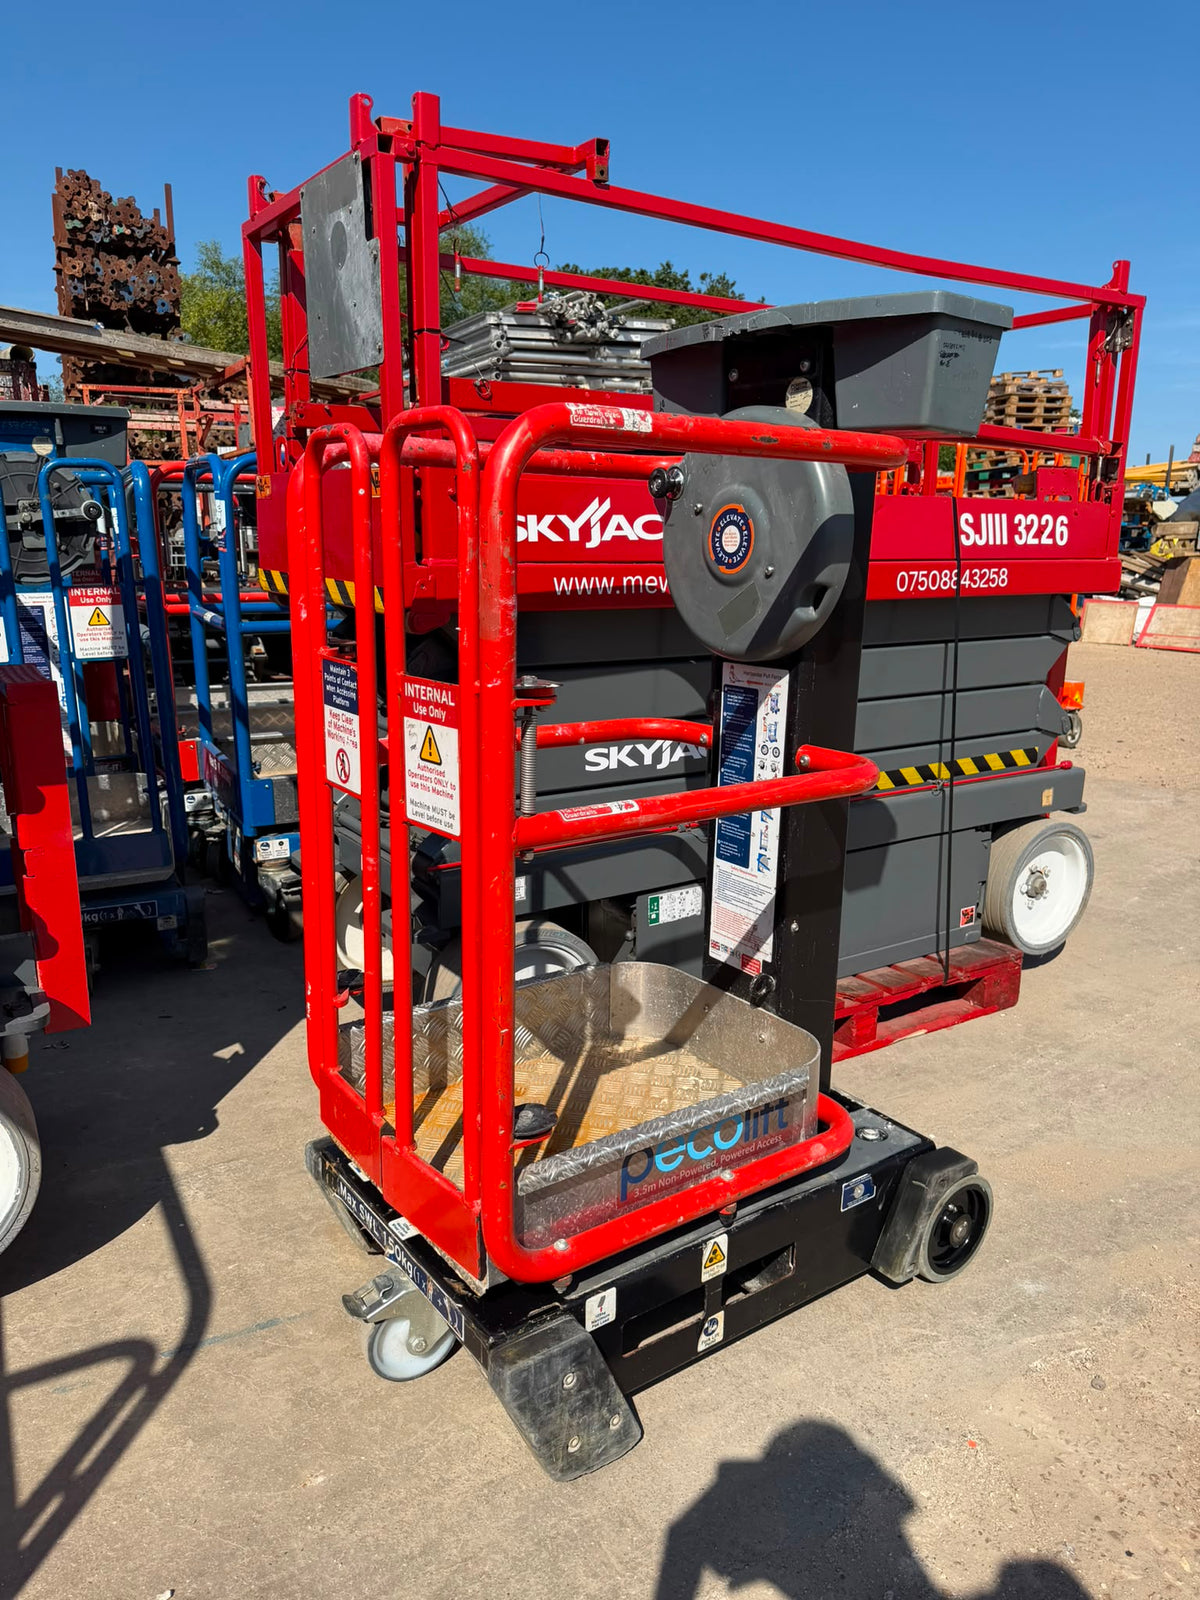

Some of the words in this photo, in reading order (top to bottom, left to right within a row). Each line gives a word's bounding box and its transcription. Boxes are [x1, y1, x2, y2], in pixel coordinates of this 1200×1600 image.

[719, 513, 745, 527] ELEVATE
[960, 512, 1008, 546] SJIII
[1013, 513, 1069, 546] 3226
[896, 567, 1009, 593] 07508843258
[70, 587, 120, 596] INTERNAL
[80, 596, 94, 604] Use
[95, 596, 112, 604] Only
[330, 664, 347, 677] Maintain
[347, 668, 351, 678] 3
[324, 672, 337, 684] Points
[341, 677, 357, 690] Contact
[326, 684, 336, 693] when
[337, 686, 356, 701] Accessing
[332, 694, 350, 707] Platform
[404, 682, 455, 706] INTERNAL
[329, 708, 340, 722] Keep
[341, 712, 354, 725] Clear
[413, 701, 427, 715] Use
[428, 705, 446, 722] Only
[327, 728, 346, 746] Working
[328, 719, 333, 728] of
[333, 720, 356, 738] Machine's
[417, 762, 446, 778] Authorised
[407, 769, 433, 784] Operators
[434, 776, 449, 788] ONLY
[450, 782, 456, 791] to
[410, 781, 419, 789] use
[420, 782, 430, 792] this
[431, 785, 454, 800] Machine
[409, 797, 430, 812] Machine
[432, 805, 447, 817] MUST
[449, 810, 456, 821] be
[411, 807, 426, 819] Level
[426, 812, 442, 826] before
[444, 820, 454, 830] use
[620, 1098, 789, 1202] pecolift
[633, 1184, 657, 1198] 3.5m
[658, 1160, 719, 1187] Non-Powered,
[720, 1144, 756, 1163] Powered
[757, 1134, 783, 1150] Access
[339, 1182, 358, 1210] Max
[359, 1203, 379, 1237] SWL
